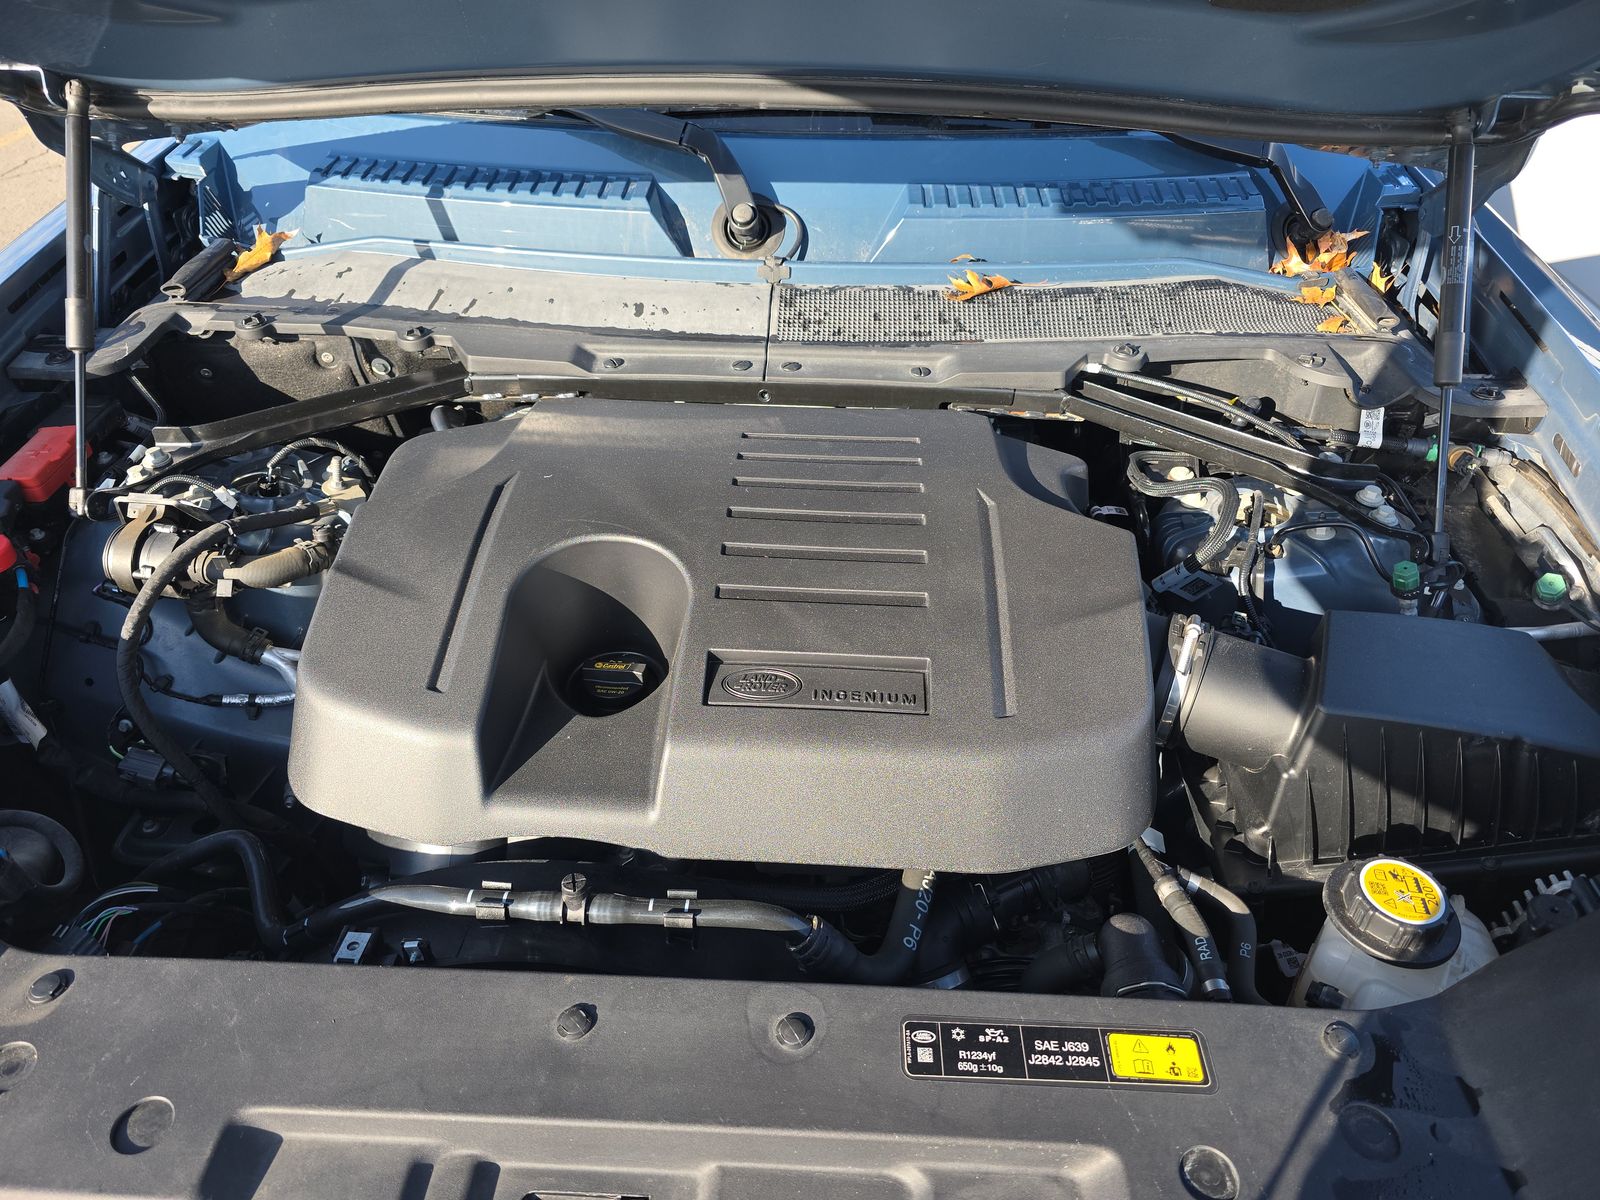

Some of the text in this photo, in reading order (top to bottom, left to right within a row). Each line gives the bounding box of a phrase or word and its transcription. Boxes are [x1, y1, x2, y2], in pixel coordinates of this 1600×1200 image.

[738, 672, 779, 684] LAND
[739, 681, 788, 693] ROVER
[811, 688, 917, 706] INGENIUM
[1194, 936, 1212, 960] RAD
[1239, 942, 1251, 958] P6
[1034, 1040, 1089, 1053] SAE J639
[958, 1050, 997, 1062] R1234yf
[1028, 1053, 1100, 1067] J2842 J2845
[957, 1061, 978, 1073] 650g
